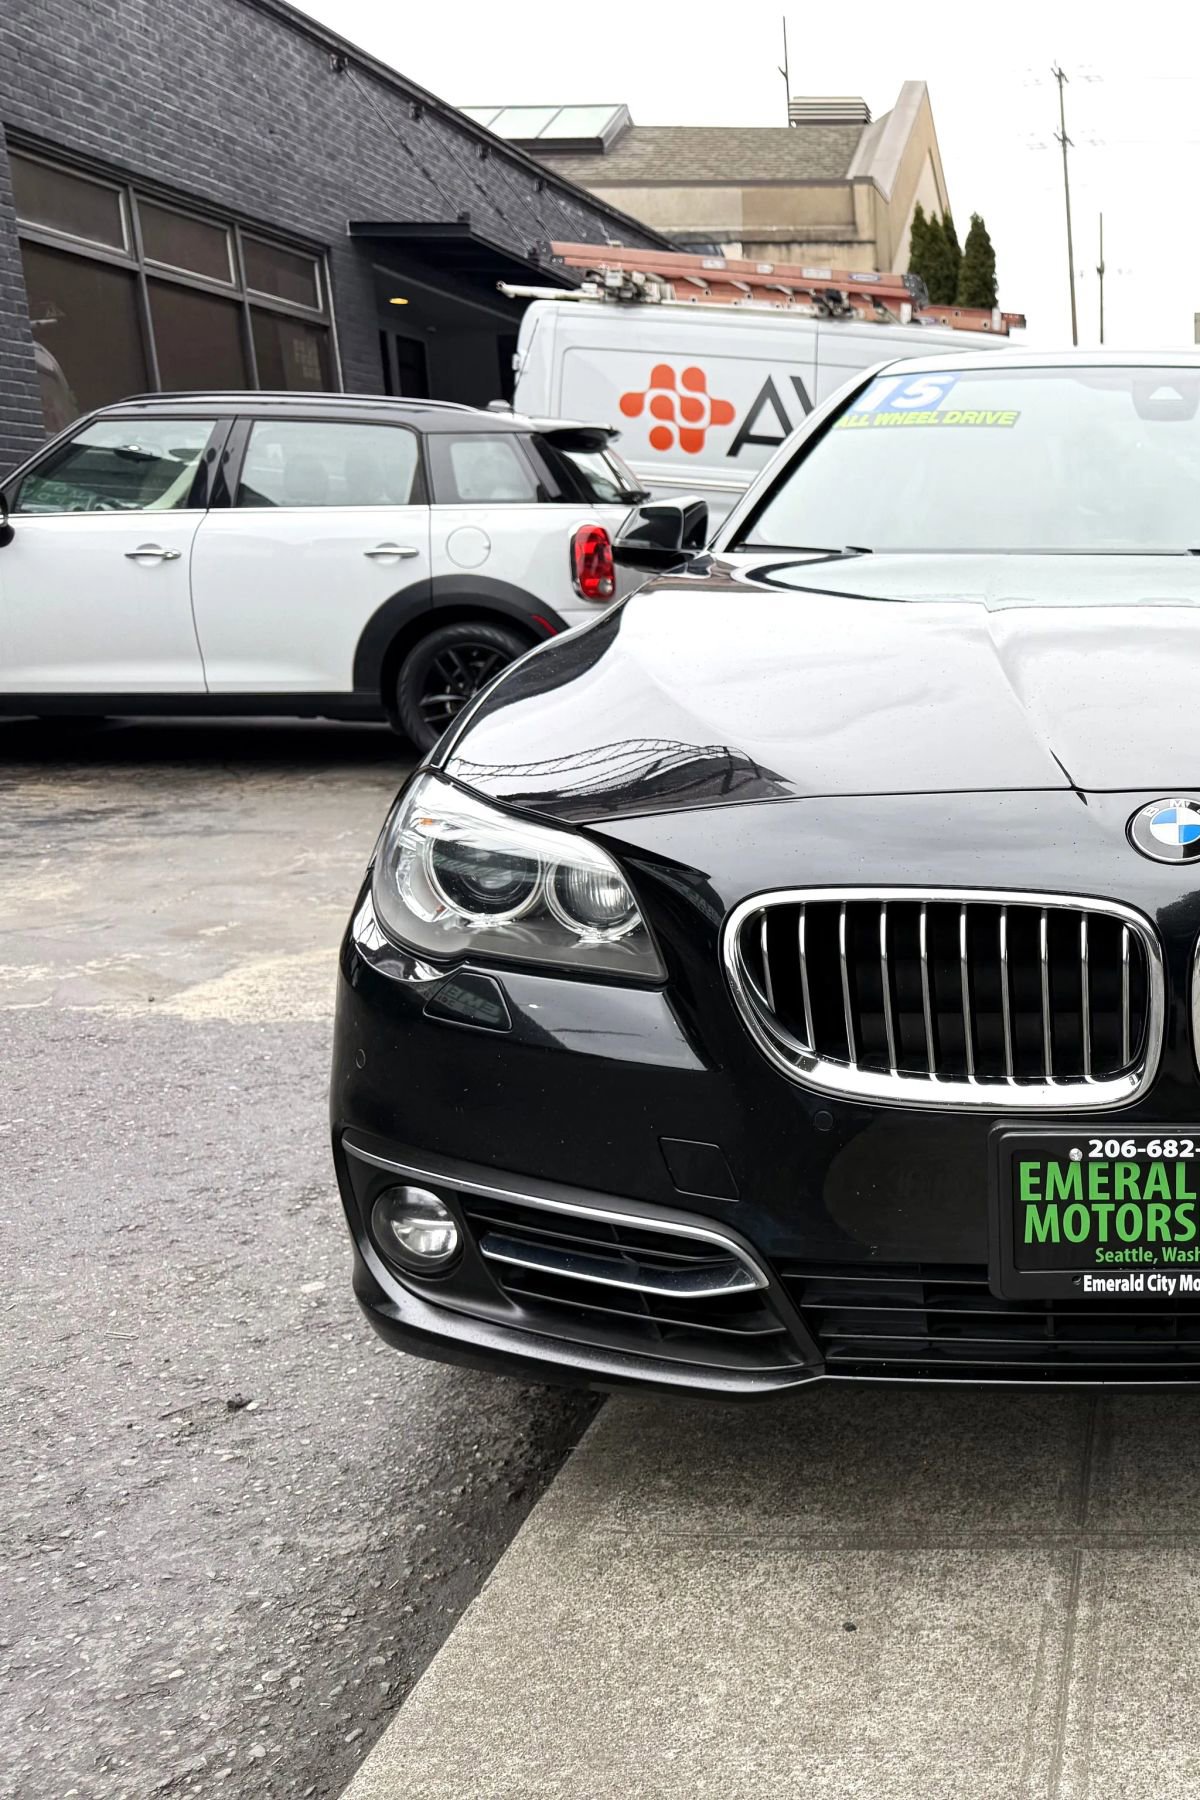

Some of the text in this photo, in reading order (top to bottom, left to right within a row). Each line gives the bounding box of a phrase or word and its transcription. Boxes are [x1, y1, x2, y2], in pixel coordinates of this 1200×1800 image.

[853, 375, 954, 412] 15
[836, 411, 1018, 428] ALL WHEEL DRIVE
[1095, 1247, 1158, 1266] Seattle,
[1083, 1274, 1144, 1292] Emerald
[1147, 1274, 1177, 1295] City
